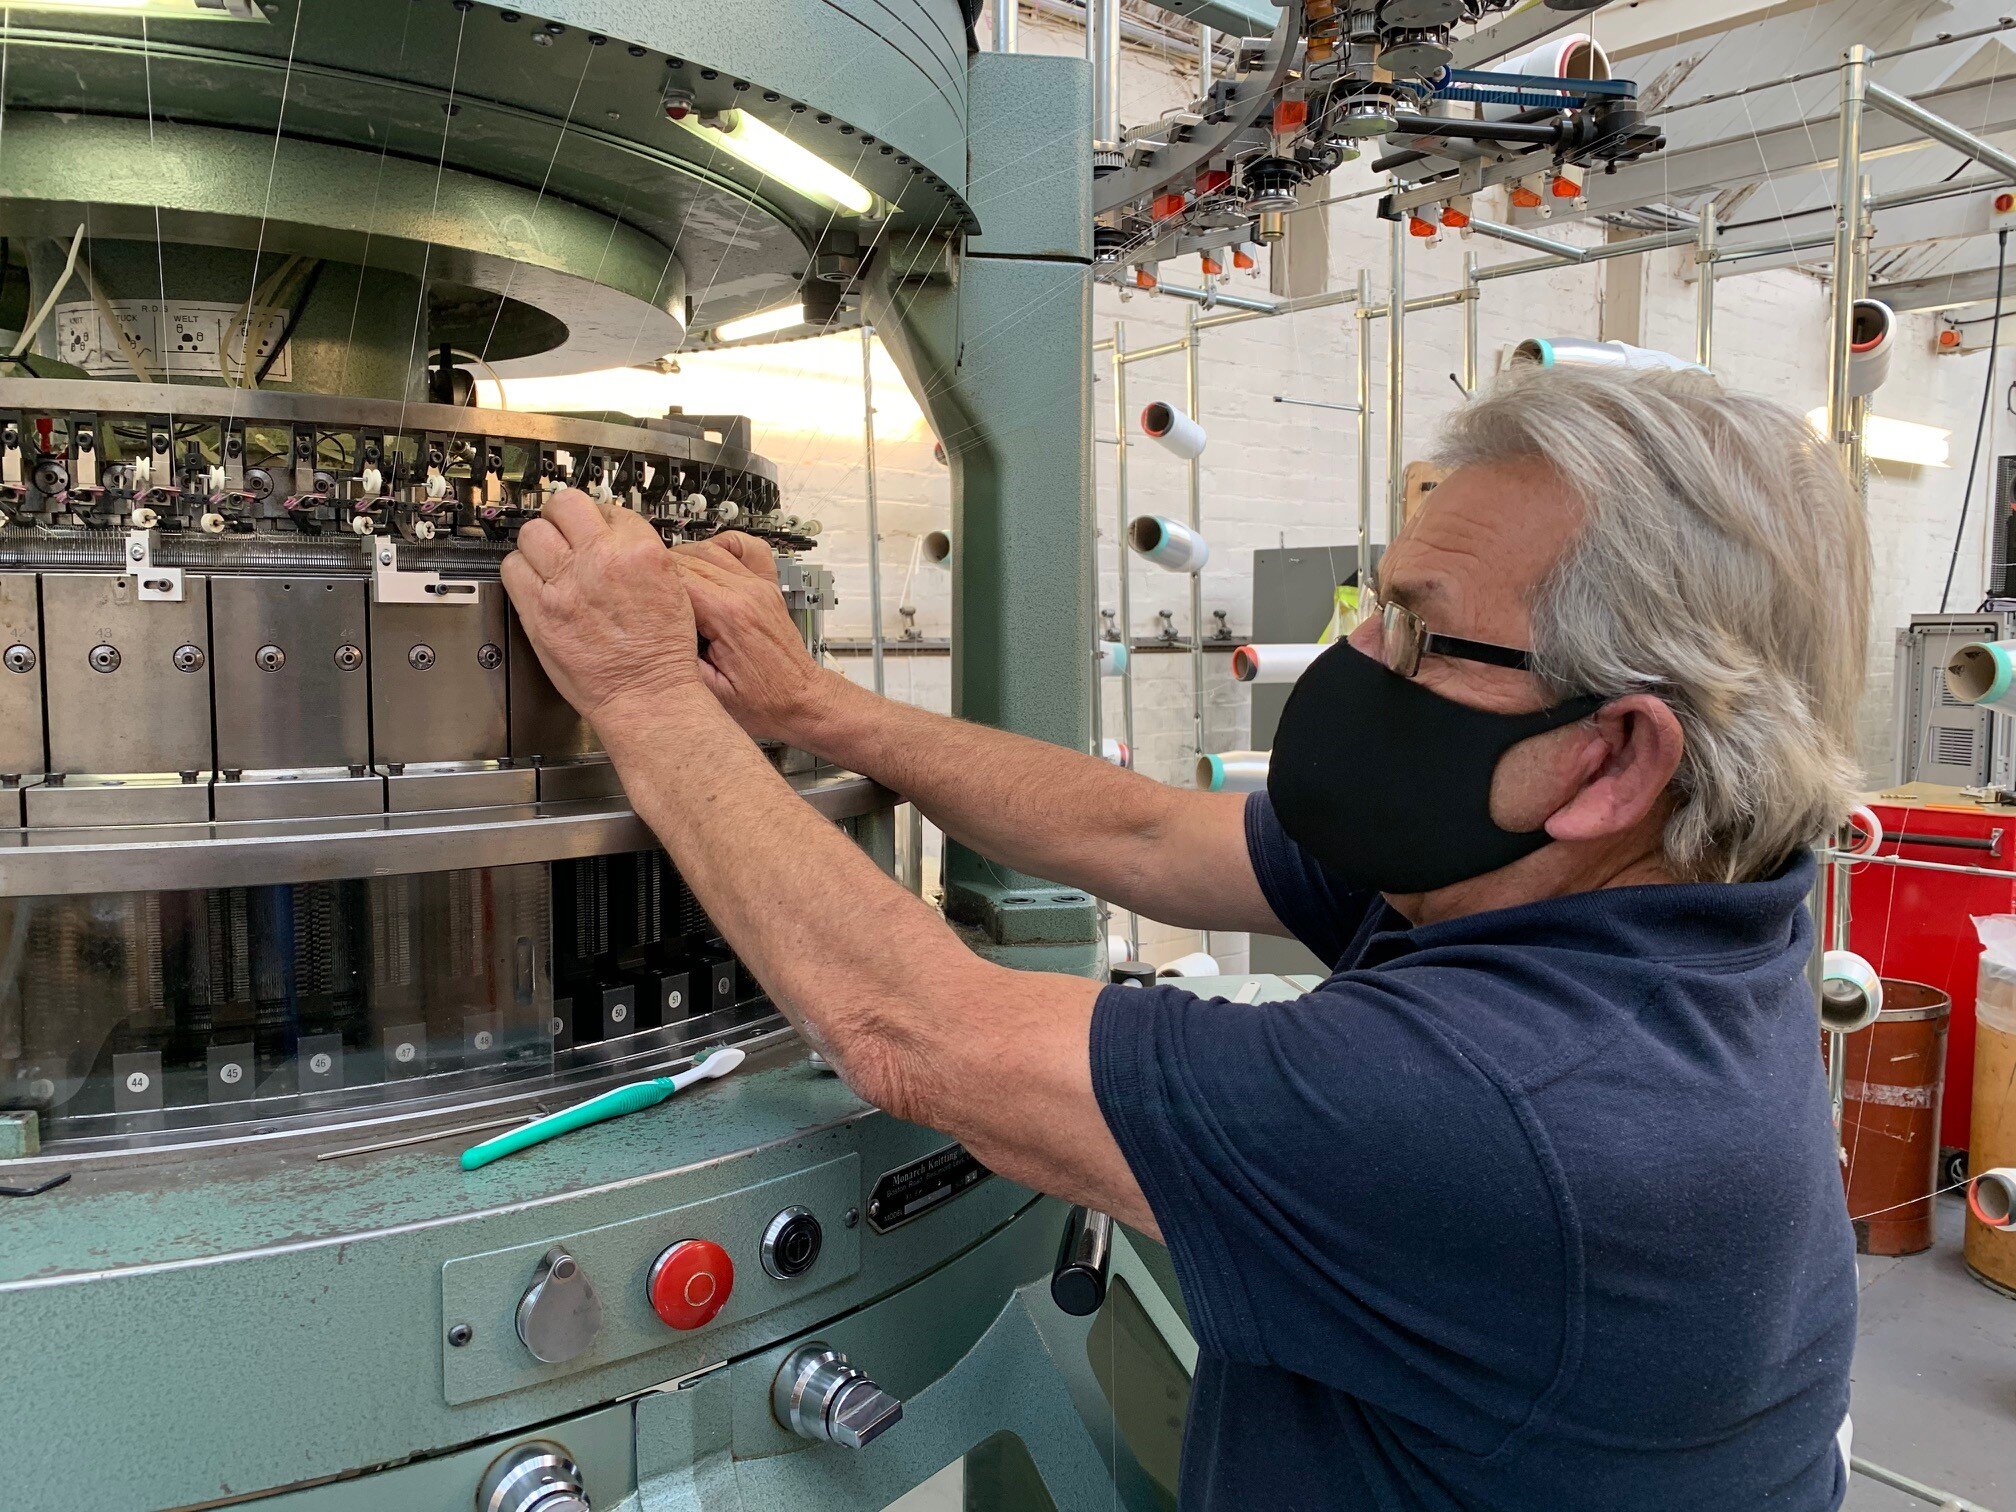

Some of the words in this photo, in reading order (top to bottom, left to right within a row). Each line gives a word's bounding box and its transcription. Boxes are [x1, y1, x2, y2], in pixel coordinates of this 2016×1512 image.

[116, 314, 138, 322] TUCK
[174, 315, 199, 323] WELT
[9, 628, 27, 638] 42
[95, 628, 113, 639] 43
[671, 995, 679, 1004] 51
[615, 1008, 624, 1018] 50
[315, 1059, 326, 1068] 46
[226, 1069, 238, 1079] 45
[131, 1077, 143, 1087] 44
[892, 1164, 926, 1185] Monarch
[928, 1151, 958, 1170] Knitting
